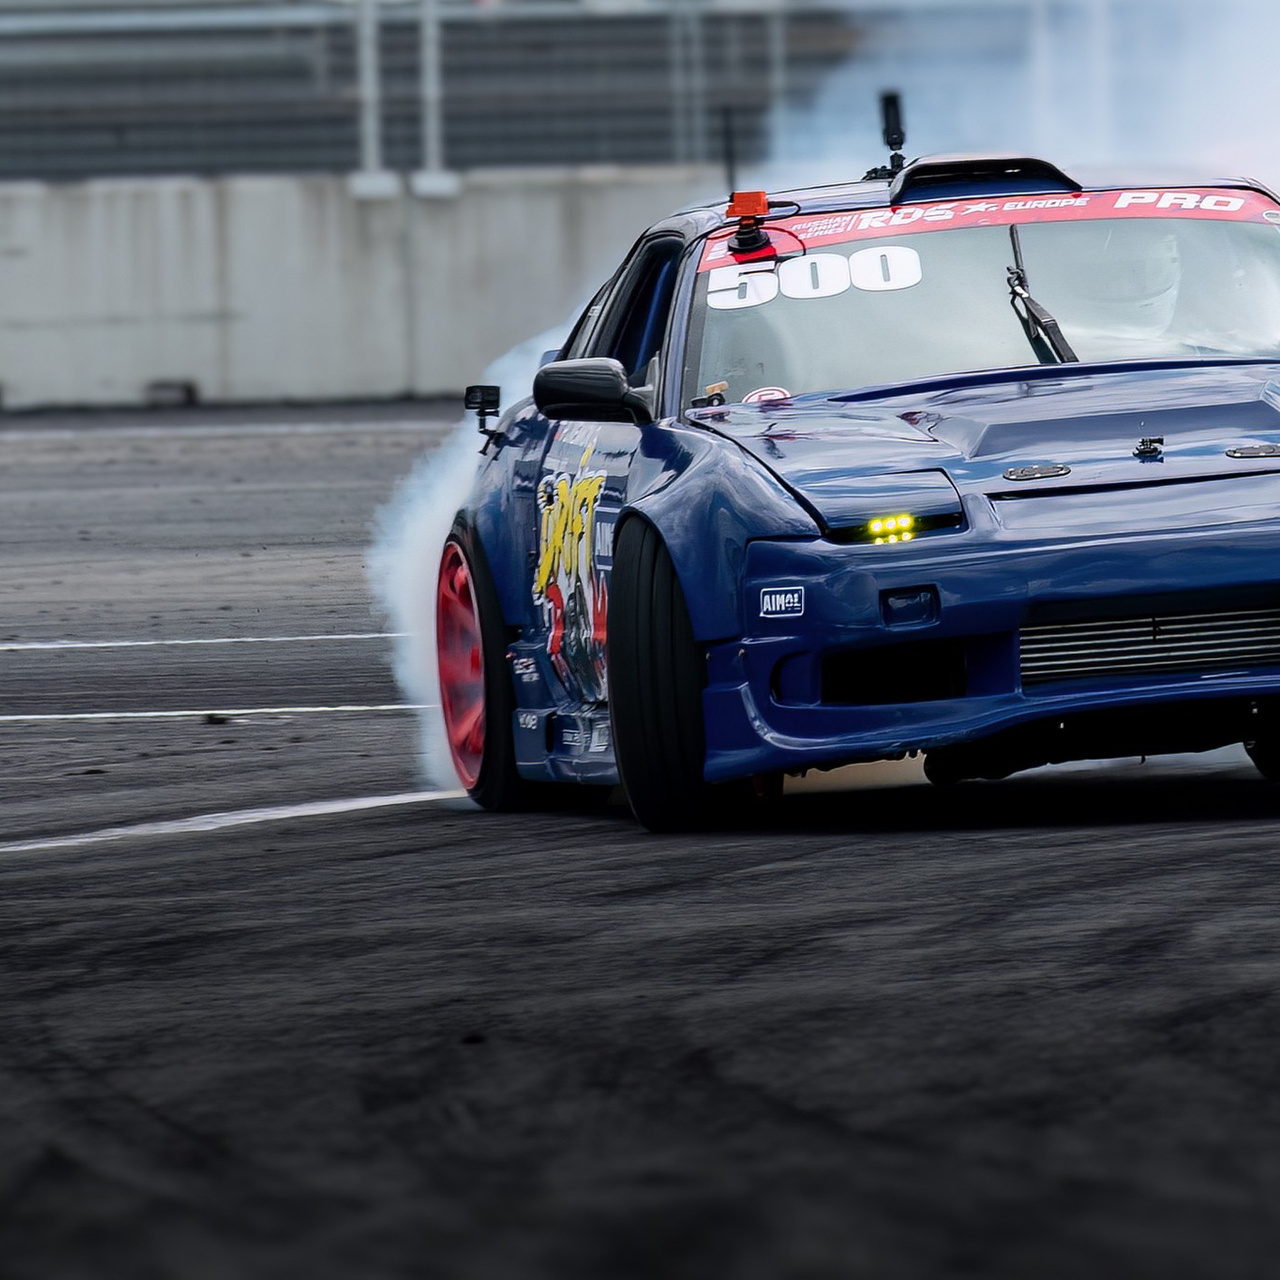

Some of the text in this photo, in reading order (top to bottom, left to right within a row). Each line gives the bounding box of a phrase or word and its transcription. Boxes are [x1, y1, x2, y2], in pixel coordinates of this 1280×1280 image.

[792, 214, 851, 231] RUSSIAN
[857, 192, 1246, 230] RDS EUROPE PRO
[797, 227, 846, 240] SERIES
[707, 245, 923, 310] 500
